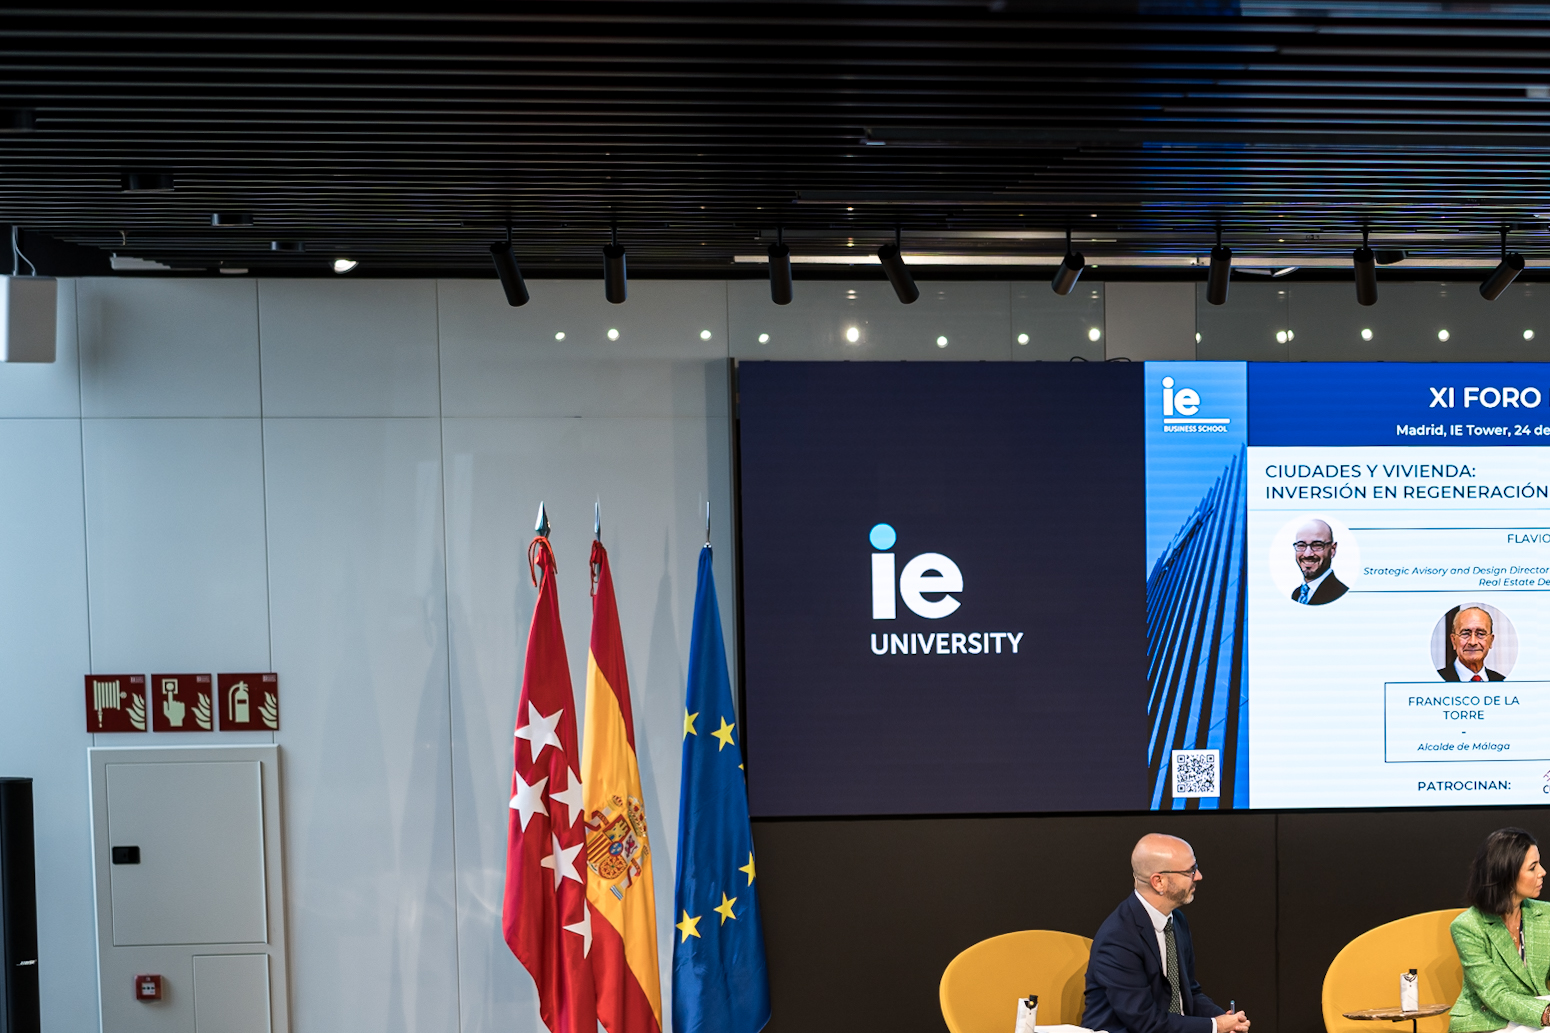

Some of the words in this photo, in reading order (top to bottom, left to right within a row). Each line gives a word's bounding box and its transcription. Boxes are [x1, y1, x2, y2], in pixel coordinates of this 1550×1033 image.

[1162, 376, 1200, 416] ie
[1429, 387, 1454, 408] XI
[1464, 387, 1541, 408] FORO
[1163, 425, 1198, 433] BUSINESS
[1197, 425, 1228, 433] SCHOOL
[1396, 423, 1448, 438] Madrid,
[1449, 424, 1464, 437] IE
[1465, 424, 1512, 438] Tower,
[1513, 424, 1532, 436] 24
[1265, 464, 1362, 479] CIUDADES
[1366, 464, 1379, 478] Y
[1382, 464, 1476, 478] VIVIENDA:
[1266, 482, 1369, 499] INVERSIÓN
[1373, 485, 1398, 499] EN
[1403, 481, 1550, 499] REGENERACIÓN
[870, 524, 963, 619] ie
[1363, 566, 1410, 577] Strategic
[1411, 566, 1449, 577] Avisory
[1449, 566, 1471, 575] and
[1472, 566, 1507, 577] Design
[1509, 565, 1550, 575] Director
[1478, 578, 1502, 587] Real
[1503, 577, 1535, 587] Estate
[871, 633, 1023, 655] UNIVERSITY
[1408, 695, 1481, 707] FRANCISCO
[1483, 695, 1501, 706] DE
[1504, 695, 1520, 706] LA
[1442, 710, 1485, 721] TORRE
[1417, 742, 1455, 751] Alcalde
[1456, 742, 1470, 751] de
[1472, 742, 1511, 753] Málaga
[1417, 780, 1511, 791] PATROCINAN:
